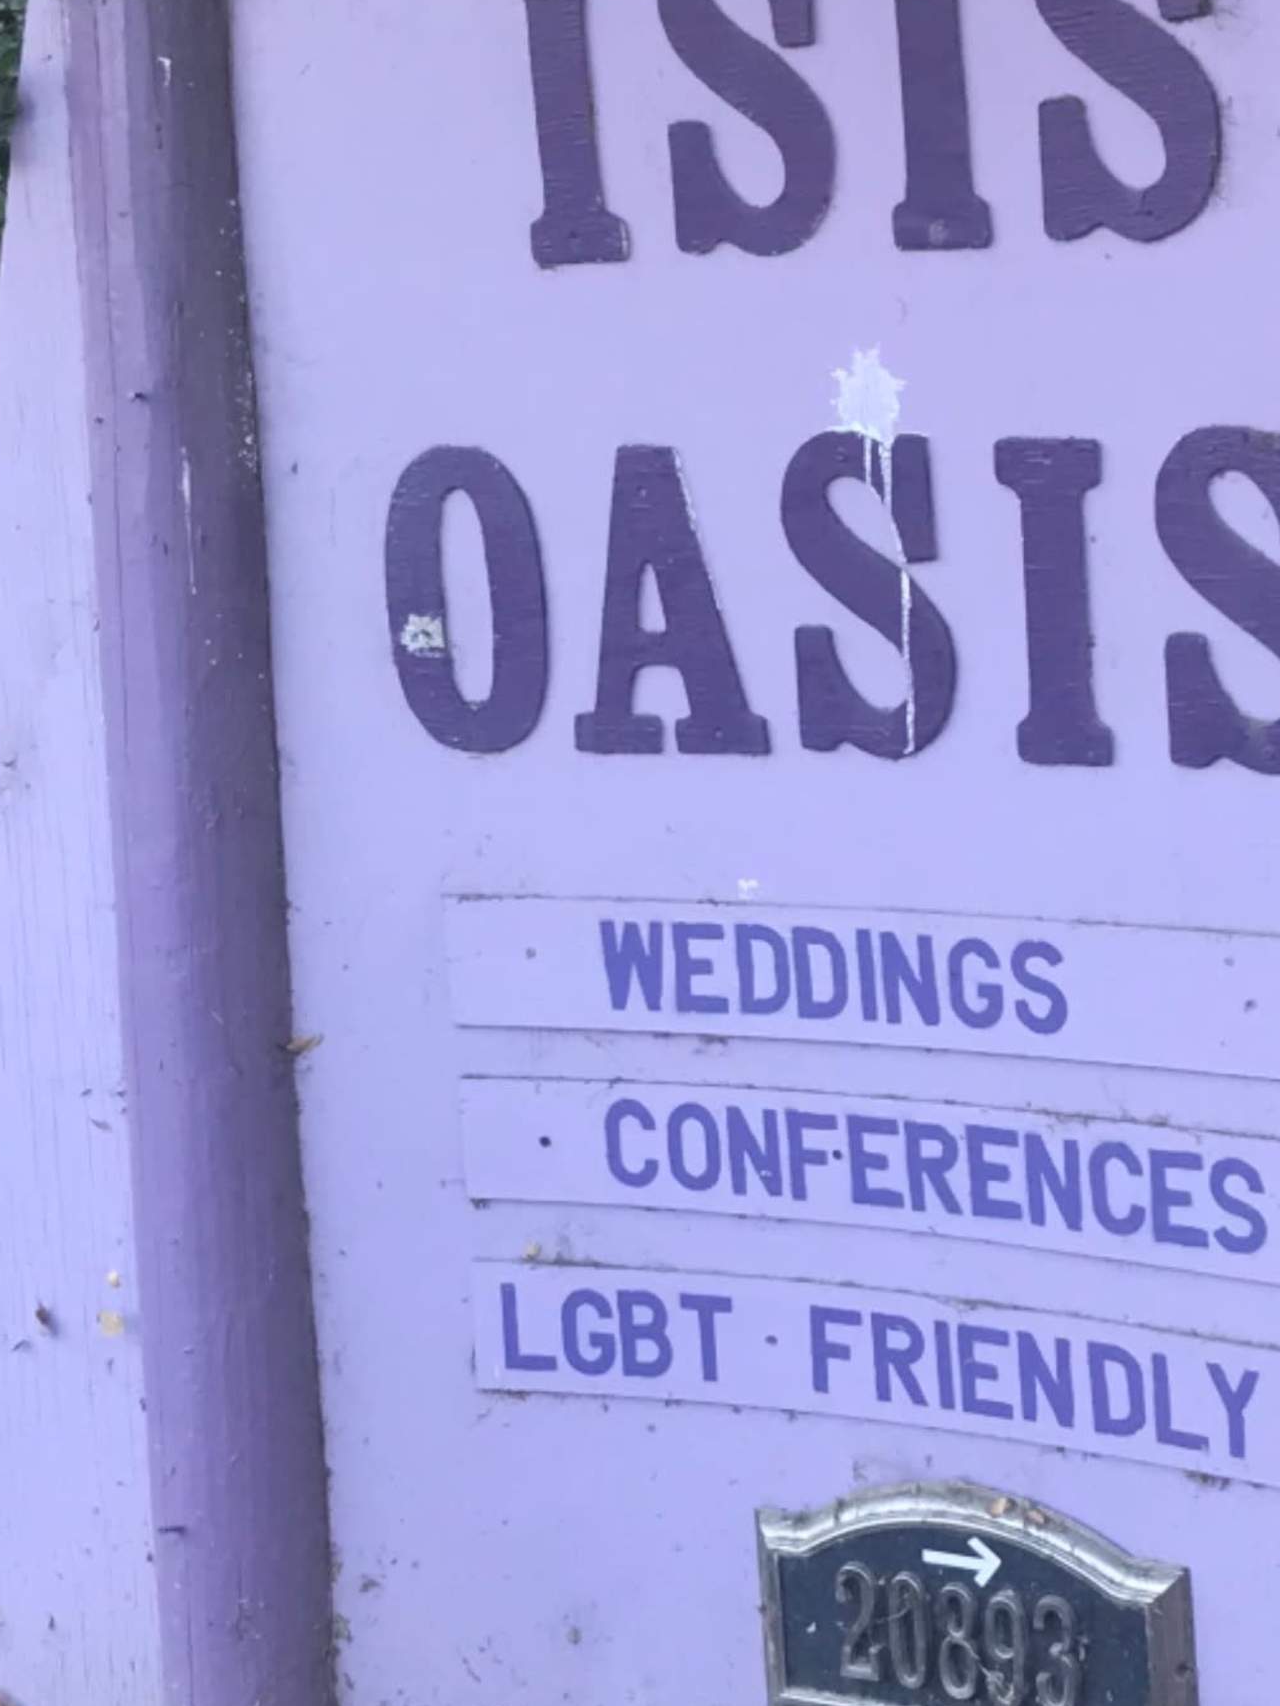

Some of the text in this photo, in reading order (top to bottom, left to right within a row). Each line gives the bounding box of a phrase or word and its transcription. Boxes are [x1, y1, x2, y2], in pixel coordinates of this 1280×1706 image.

[600, 920, 1068, 1034] WEDDINGS
[605, 1099, 1267, 1254] CONFERENCES
[500, 1283, 1260, 1458] LGBT FRIENDLY
